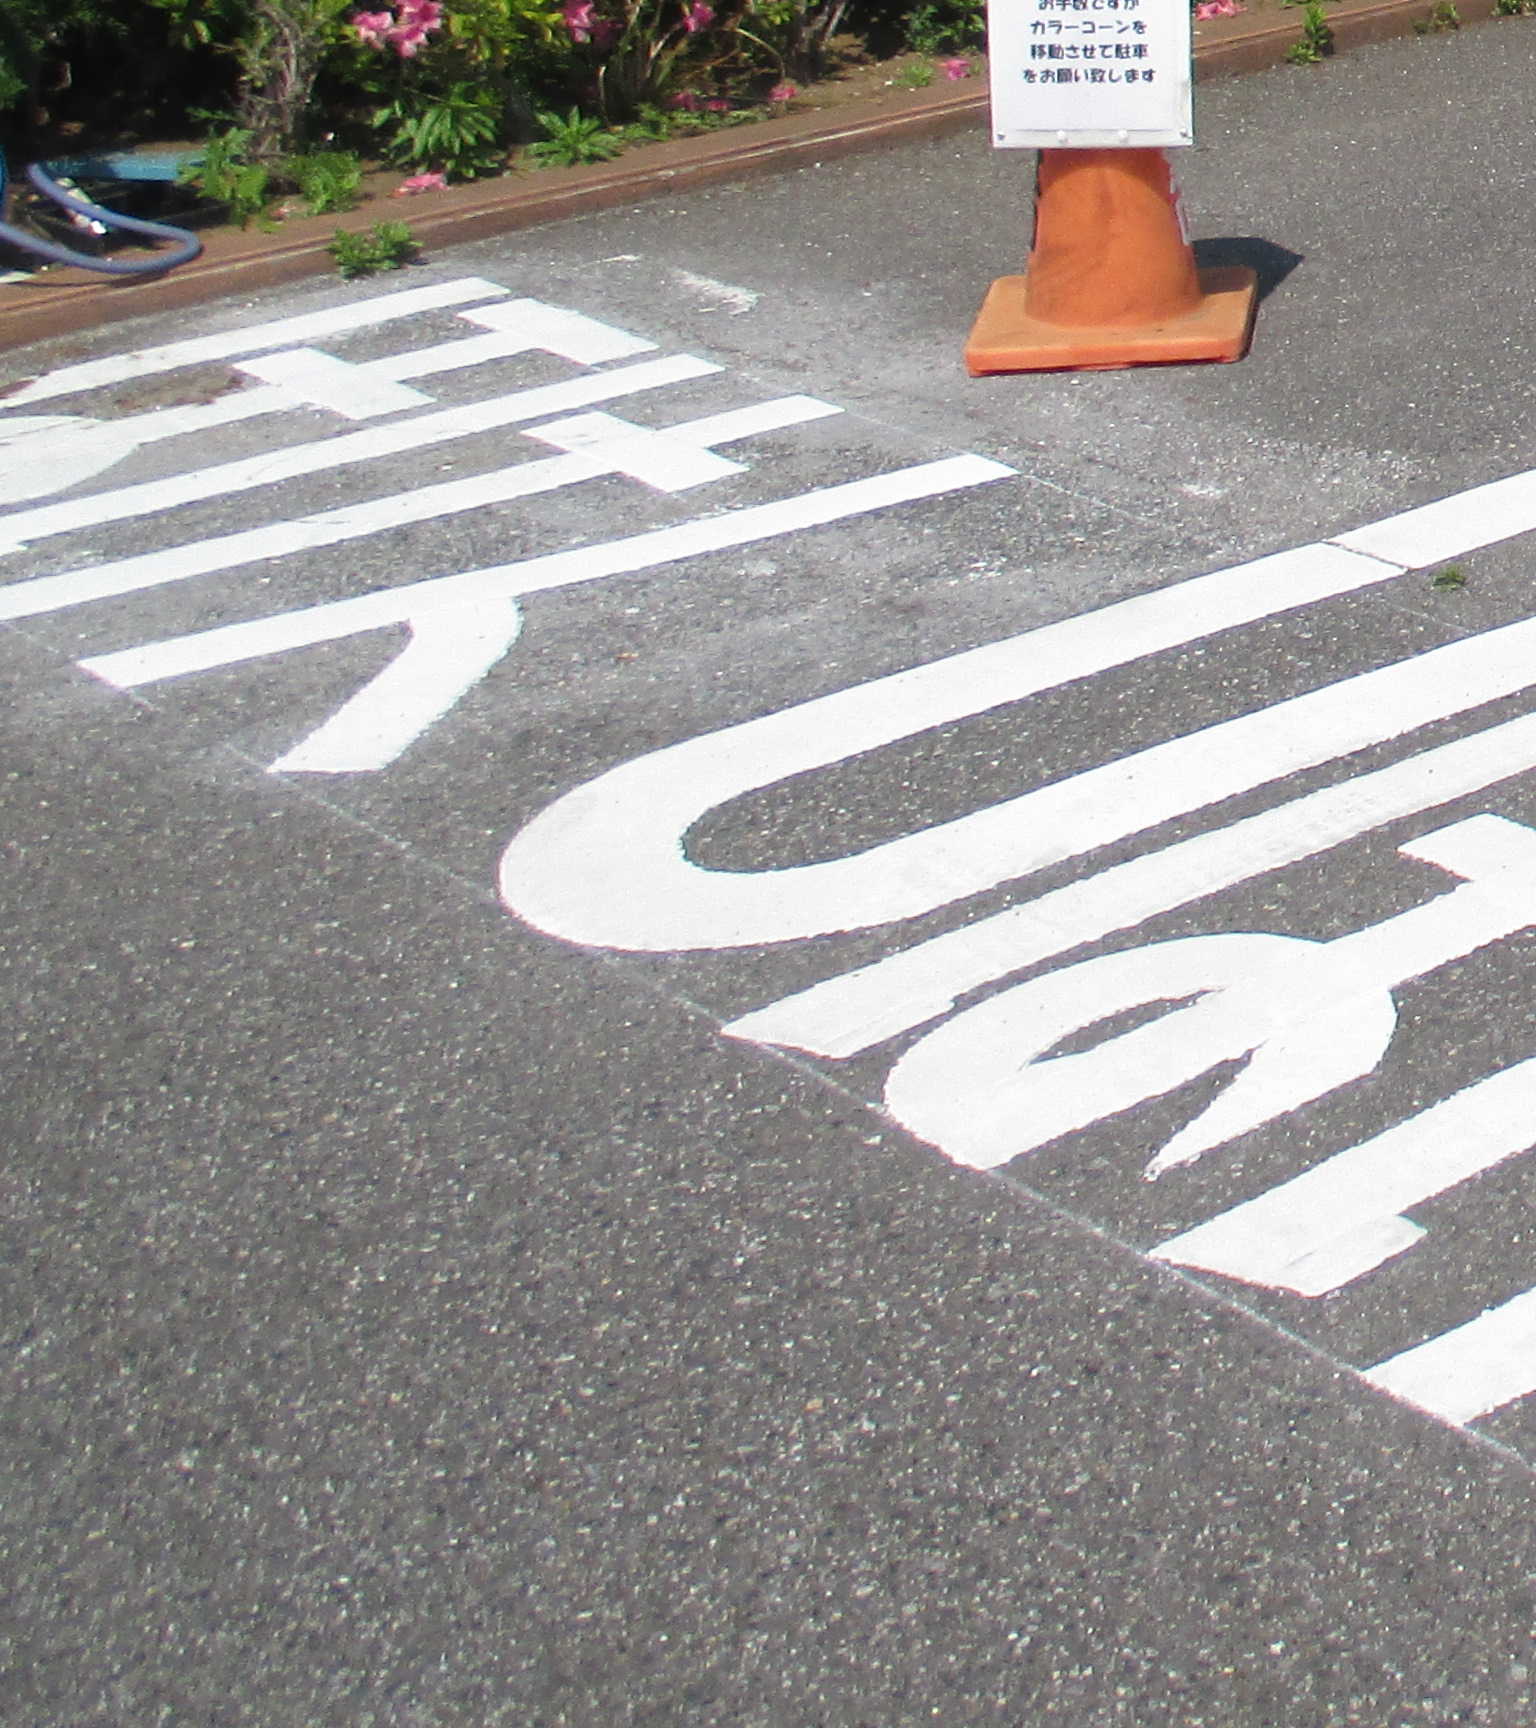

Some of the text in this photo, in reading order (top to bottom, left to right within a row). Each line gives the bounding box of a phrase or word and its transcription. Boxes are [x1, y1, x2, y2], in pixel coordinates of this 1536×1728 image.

[1029, 20, 1147, 35] カラーコーンを
[1030, 44, 1149, 60] 移動させて駐車
[1023, 68, 1156, 84] をお願い致します
